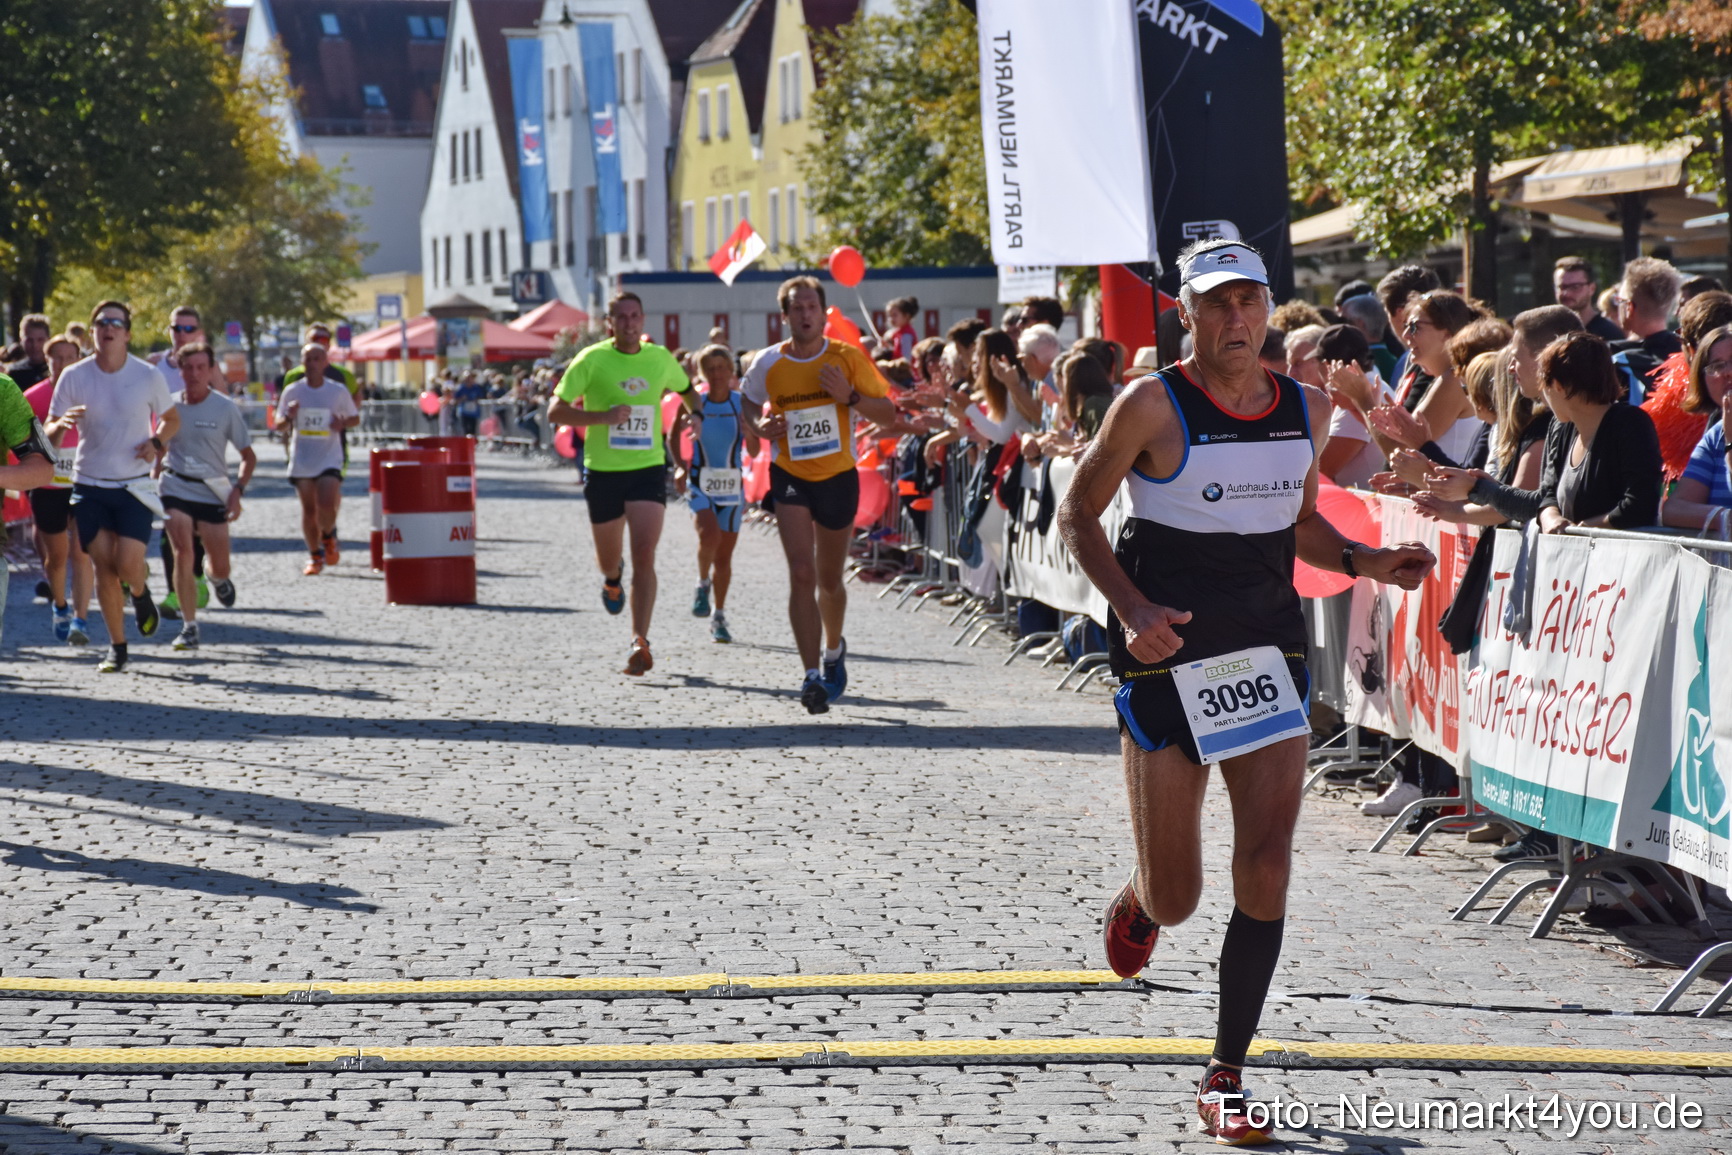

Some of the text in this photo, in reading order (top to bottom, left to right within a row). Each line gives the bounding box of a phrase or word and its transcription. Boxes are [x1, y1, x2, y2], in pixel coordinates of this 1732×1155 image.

[1136, 0, 1229, 54] ARKT
[776, 388, 834, 408] Continenta
[793, 419, 831, 439] 2246
[705, 478, 736, 491] 2019
[1226, 483, 1269, 493] Autohaus
[1282, 480, 1292, 490] B.
[1293, 479, 1304, 489] LE
[1226, 493, 1257, 501] Leidenschaft
[1125, 668, 1169, 678] aquamar
[1205, 658, 1253, 678] BOCK
[1198, 674, 1278, 717] 3096
[1214, 709, 1269, 728] PARTL Neumarkt
